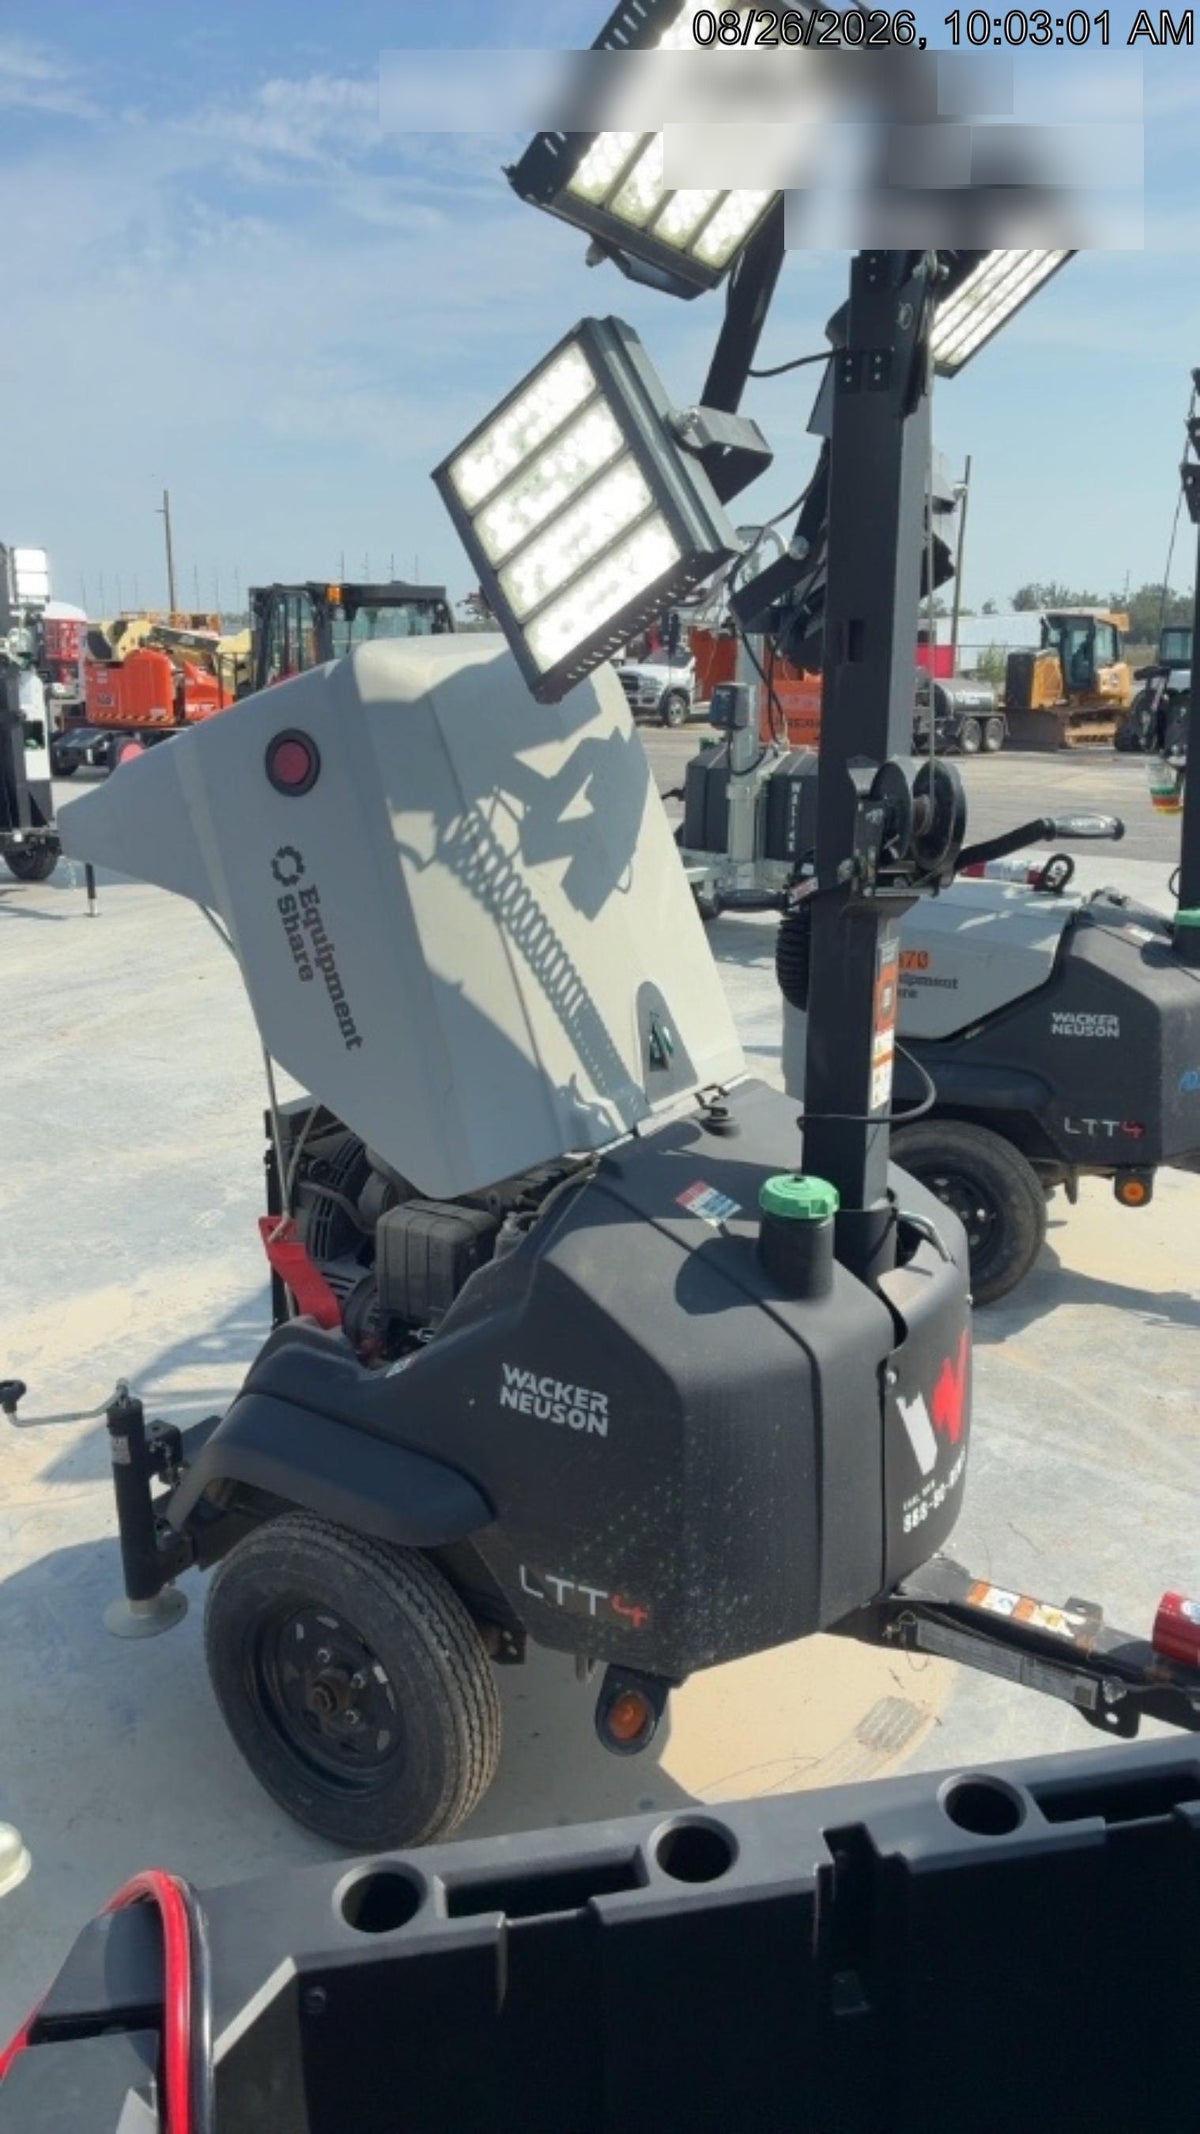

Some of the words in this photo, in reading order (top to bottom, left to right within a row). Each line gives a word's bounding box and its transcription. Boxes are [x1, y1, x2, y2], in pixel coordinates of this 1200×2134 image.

[277, 894, 314, 982] Share
[298, 884, 363, 1050] Equipment
[1051, 1011, 1120, 1026] WACKER
[1051, 1023, 1120, 1038] NEUSON
[1064, 1116, 1144, 1139] LTT4
[500, 1385, 608, 1437] NEUSON
[501, 1362, 608, 1415] WACKER
[519, 1564, 648, 1628] LTT4
